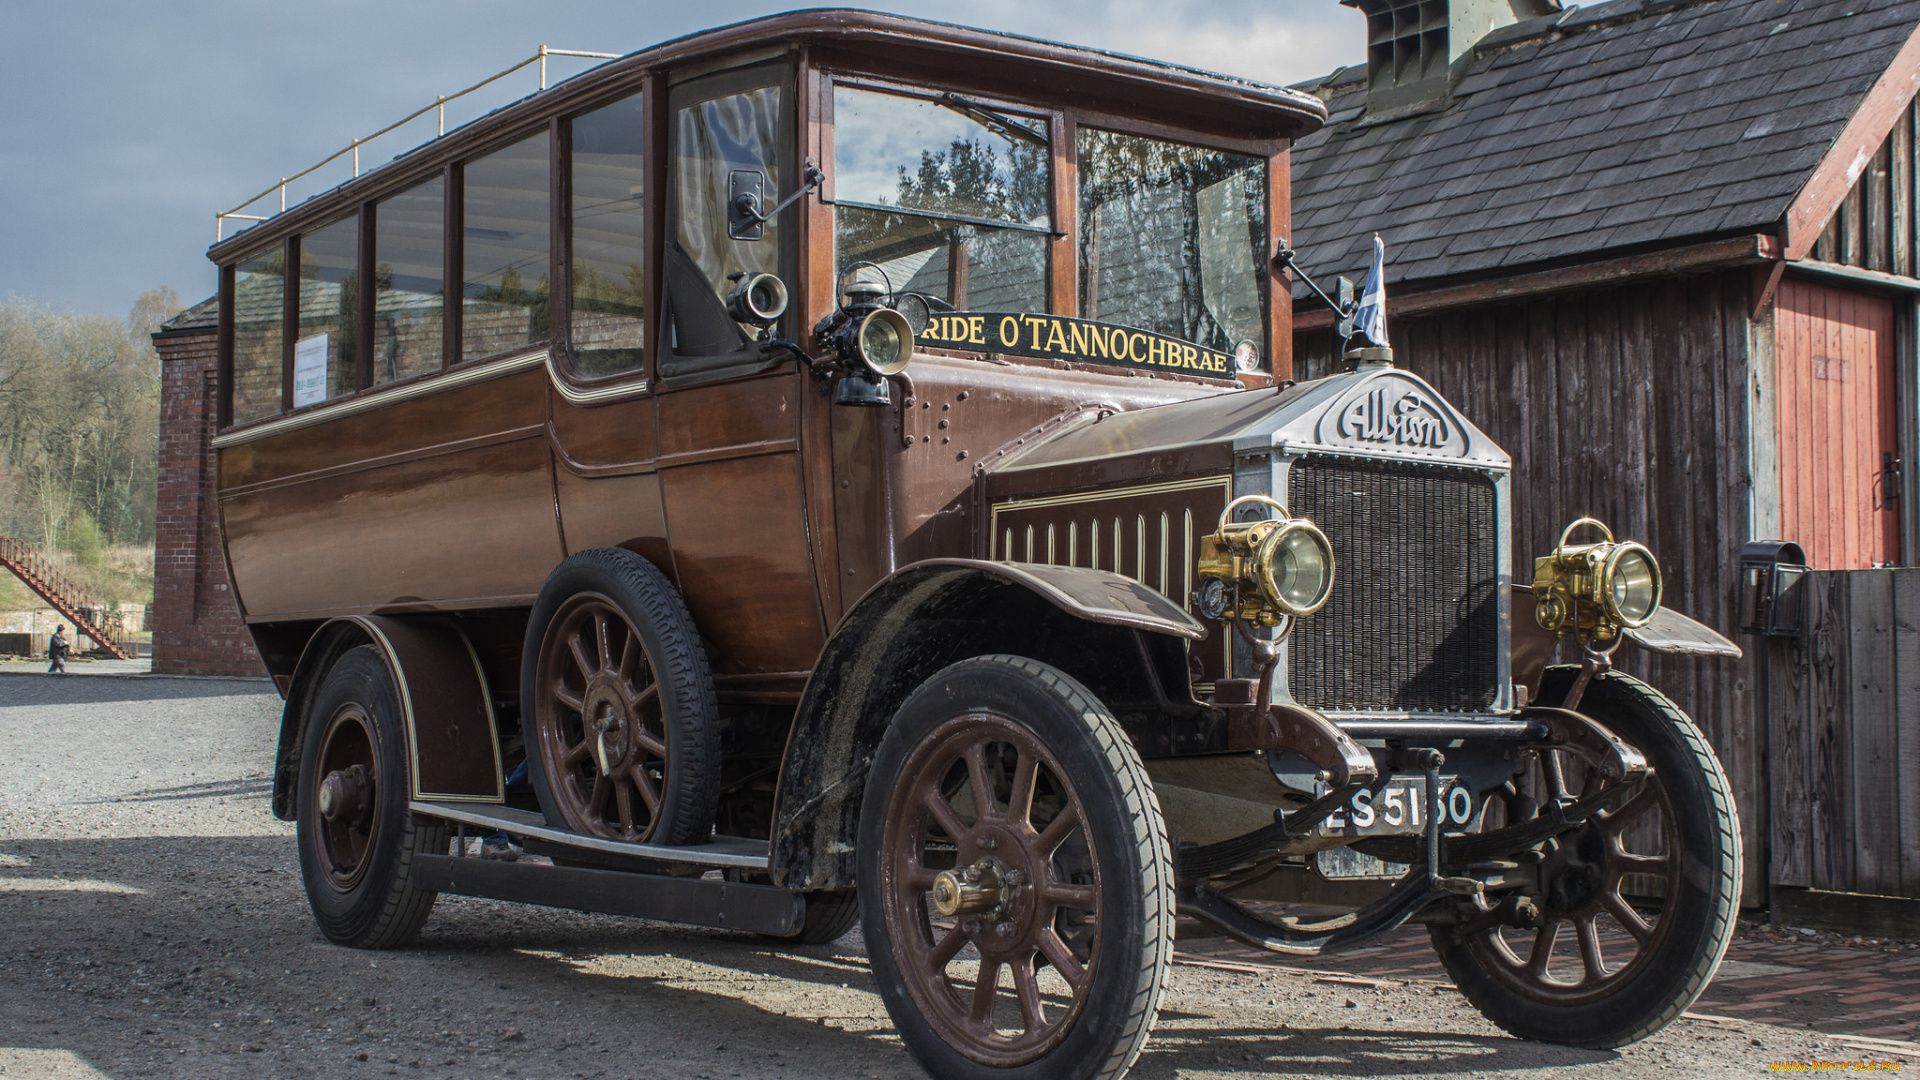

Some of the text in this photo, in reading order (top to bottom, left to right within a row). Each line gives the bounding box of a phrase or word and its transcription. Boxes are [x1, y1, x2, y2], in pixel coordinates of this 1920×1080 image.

[921, 316, 986, 345] RIDE
[1000, 312, 1227, 373] O'TANNOCHBRAE
[1341, 389, 1449, 447] Albion
